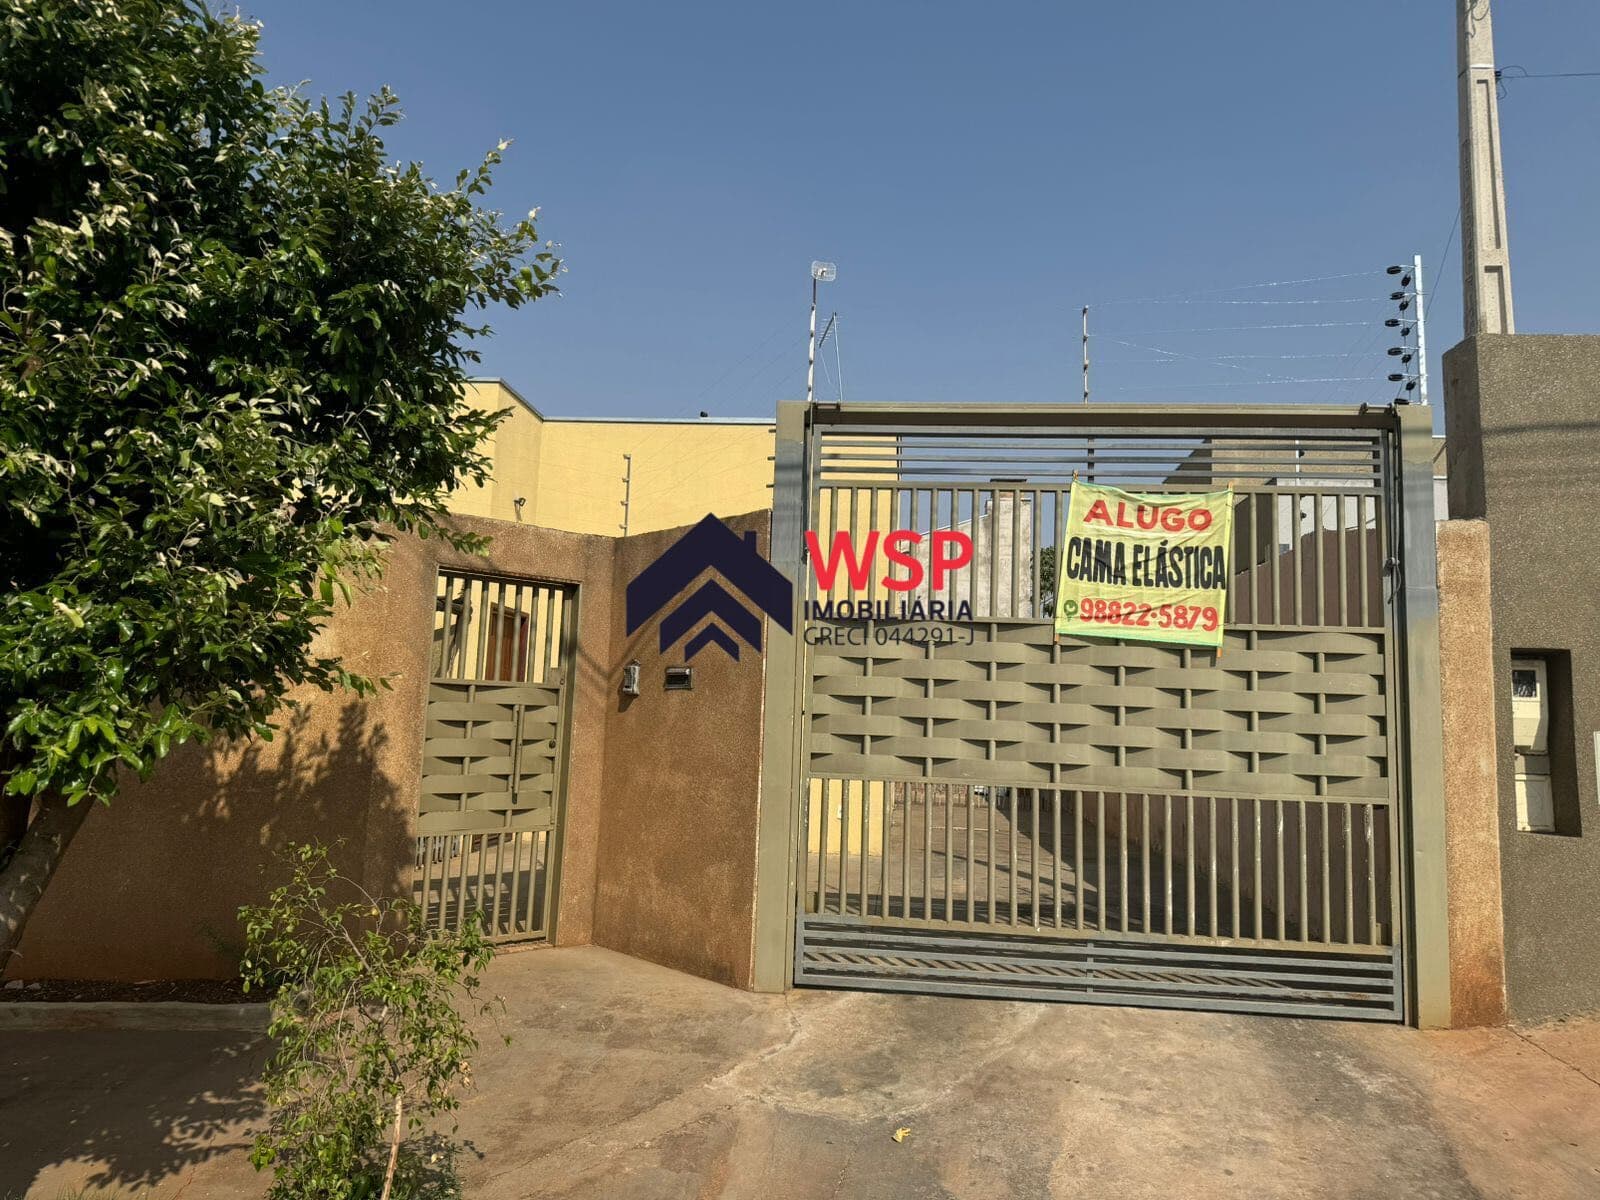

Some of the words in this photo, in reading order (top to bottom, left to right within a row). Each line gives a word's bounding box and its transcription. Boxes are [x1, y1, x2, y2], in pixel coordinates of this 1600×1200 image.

[1083, 499, 1213, 532] ALUGO
[1066, 536, 1127, 586] CAMA
[1132, 539, 1226, 590] ELÁSTICA
